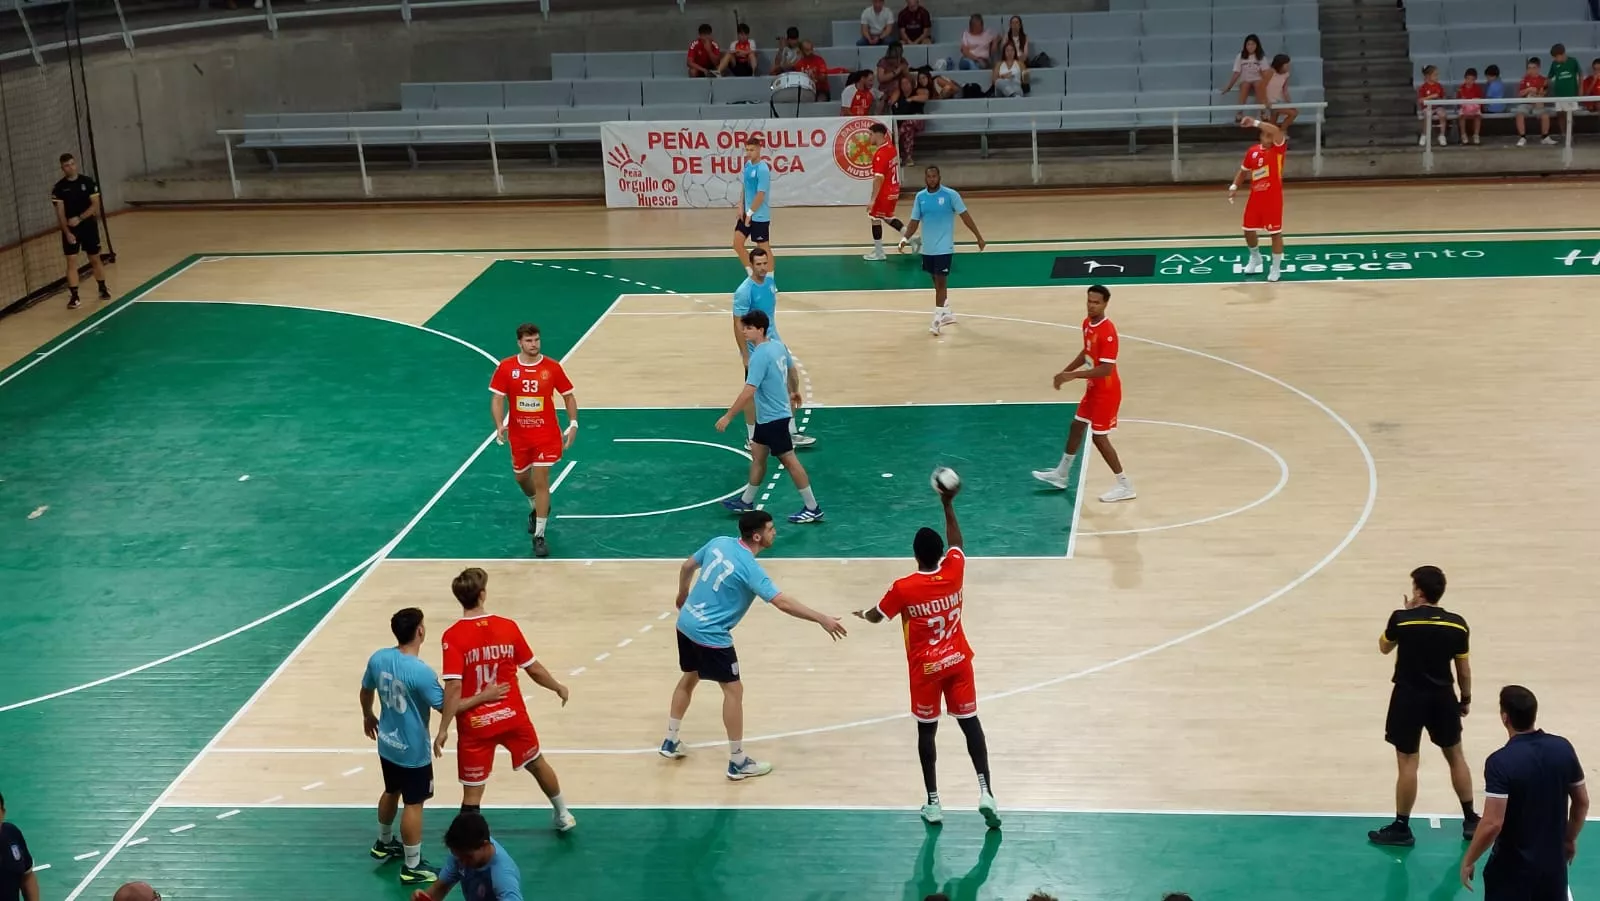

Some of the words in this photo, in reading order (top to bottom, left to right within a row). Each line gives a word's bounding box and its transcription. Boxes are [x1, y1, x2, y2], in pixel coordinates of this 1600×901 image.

[647, 127, 710, 150] PEÑA
[672, 156, 704, 175] DE
[619, 177, 659, 193] Orgullo
[637, 193, 679, 207] Huesca
[1160, 264, 1213, 275] de
[522, 379, 539, 393] 33
[701, 547, 735, 592] 77
[927, 607, 961, 646] 32
[482, 644, 515, 661] MOYA
